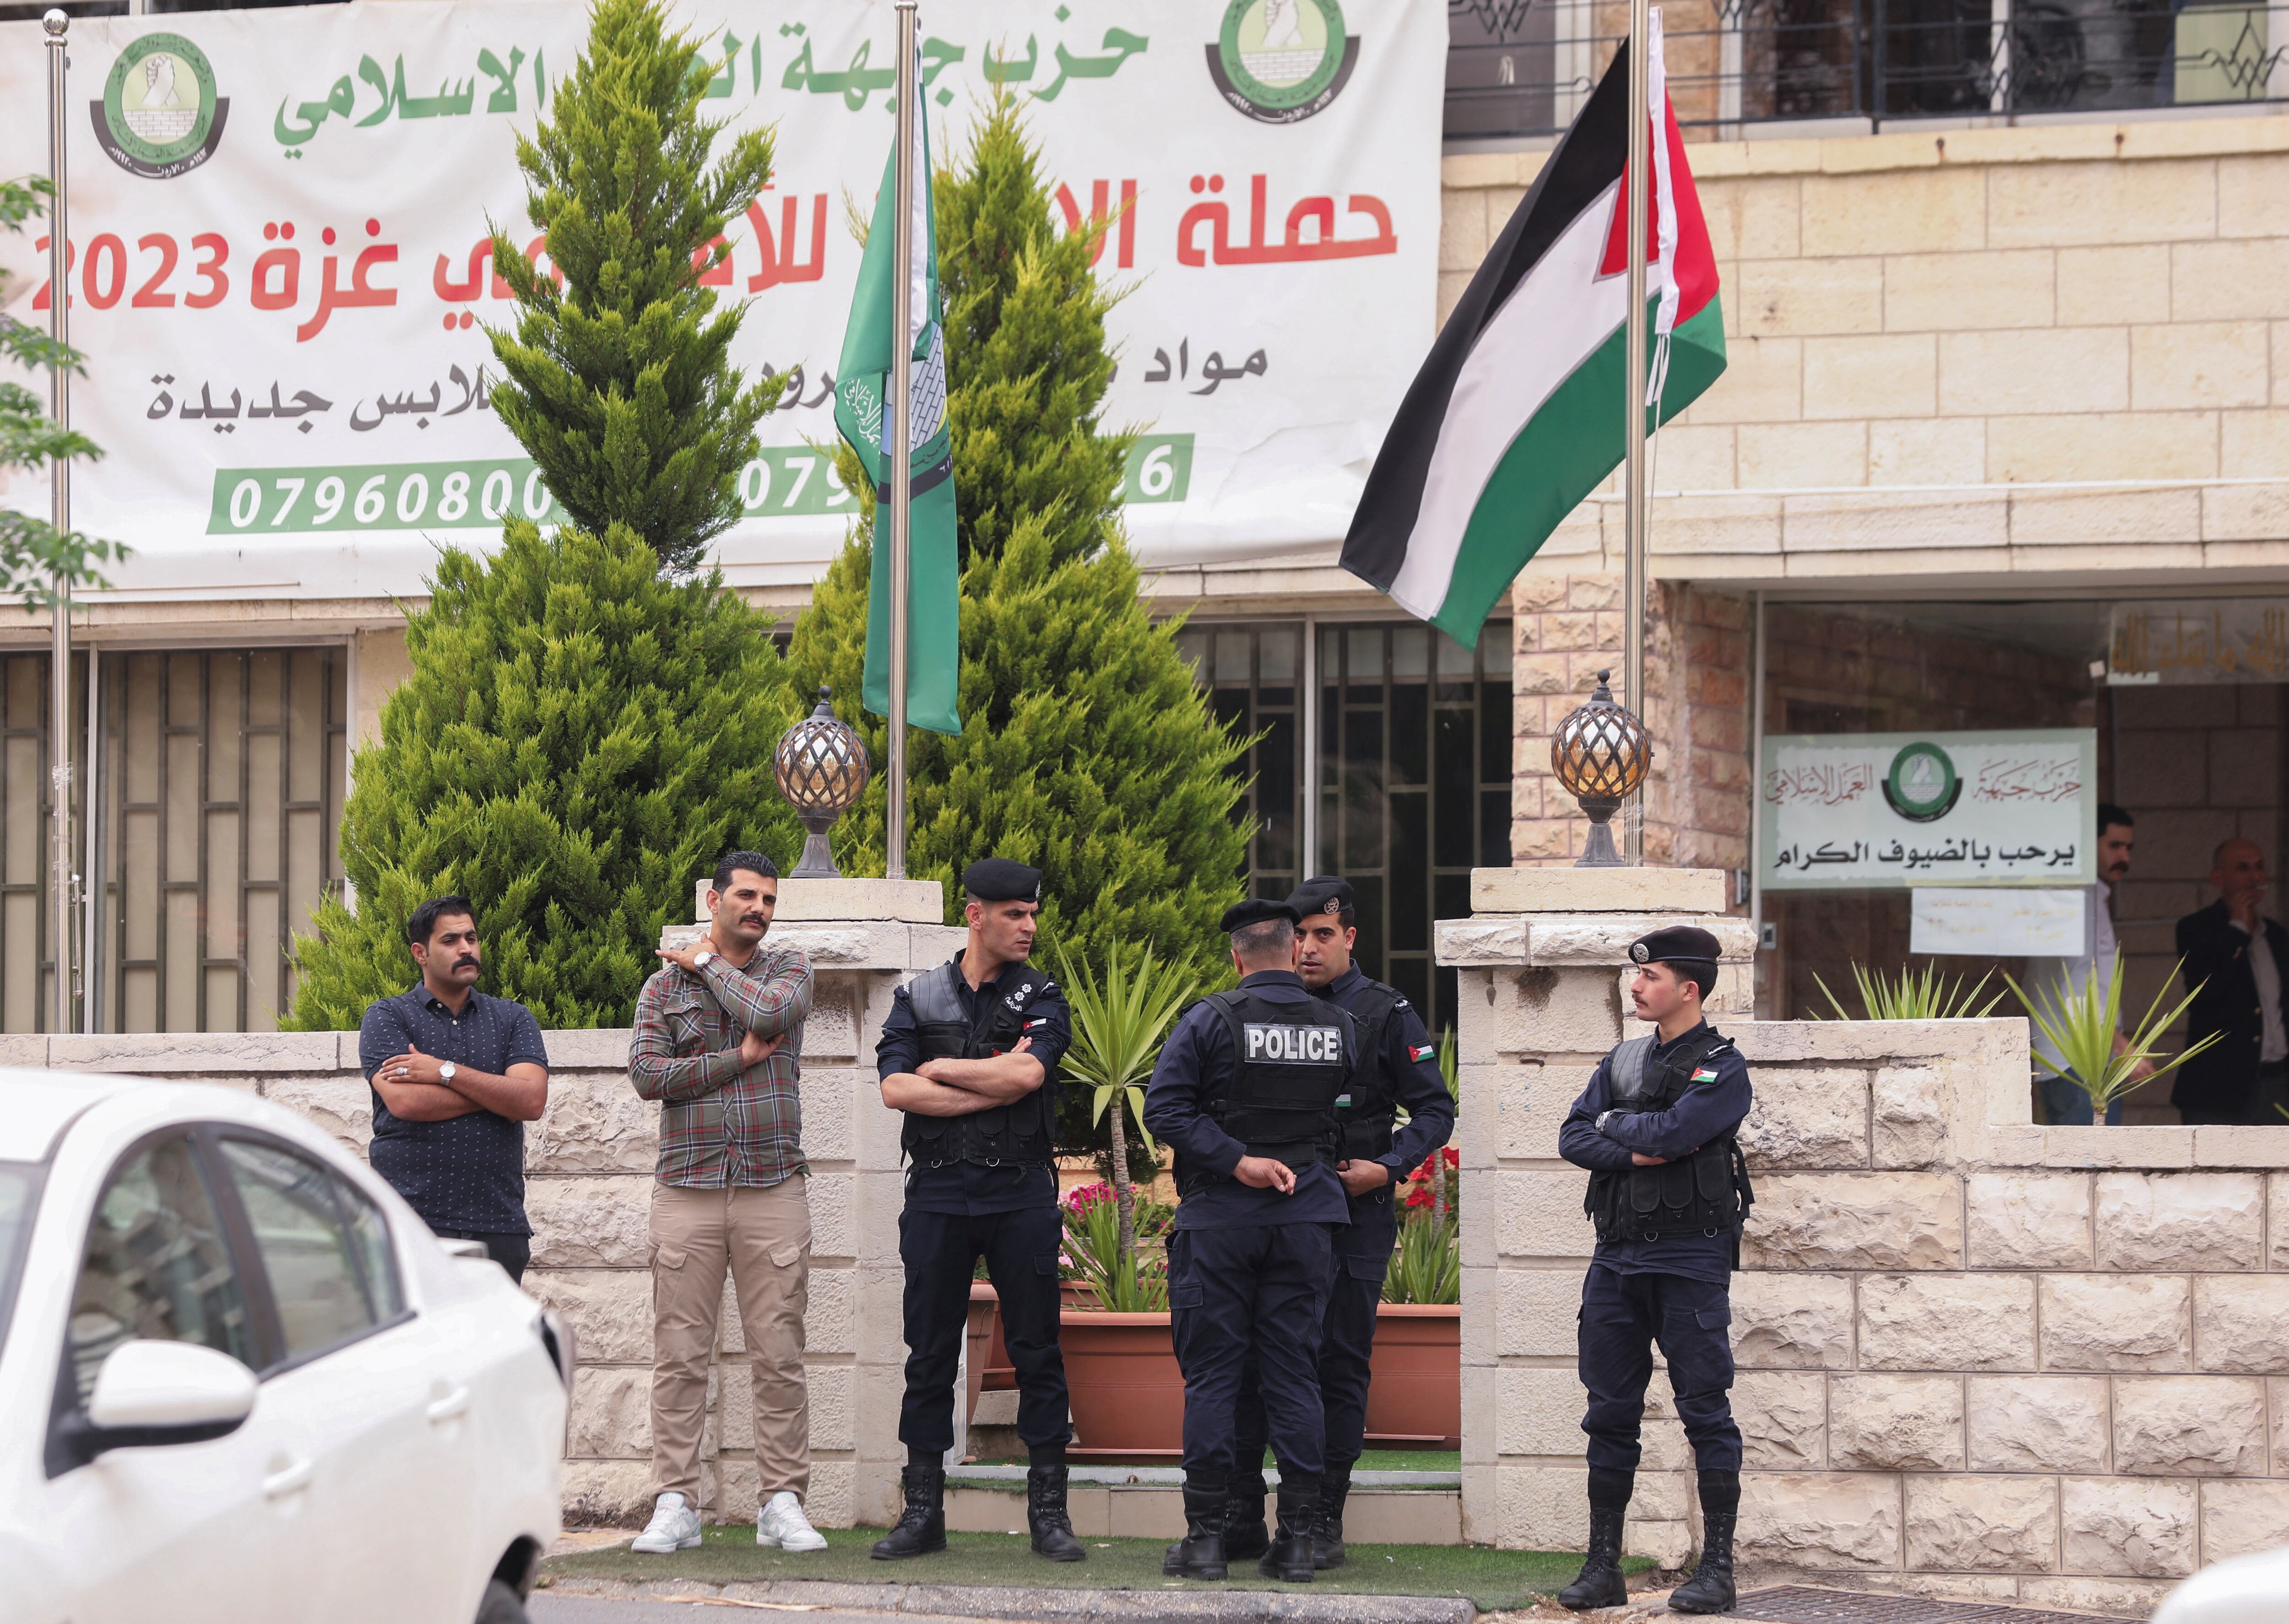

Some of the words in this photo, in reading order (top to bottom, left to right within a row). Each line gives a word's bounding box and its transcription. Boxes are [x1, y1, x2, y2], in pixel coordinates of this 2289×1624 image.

[982, 4, 1149, 108] حزب
[1177, 174, 1397, 267] حملة
[33, 233, 229, 310] 2023
[250, 218, 398, 342] غزة
[1144, 336, 1268, 395] مواد
[147, 374, 333, 433] جديدة
[349, 363, 491, 432] لابس
[229, 465, 553, 528] 07960800
[1774, 841, 1868, 870] الكرام
[1878, 839, 1991, 869] بالضيوف
[1999, 841, 2075, 866] يرحب
[1249, 1029, 1338, 1061] POLICE
